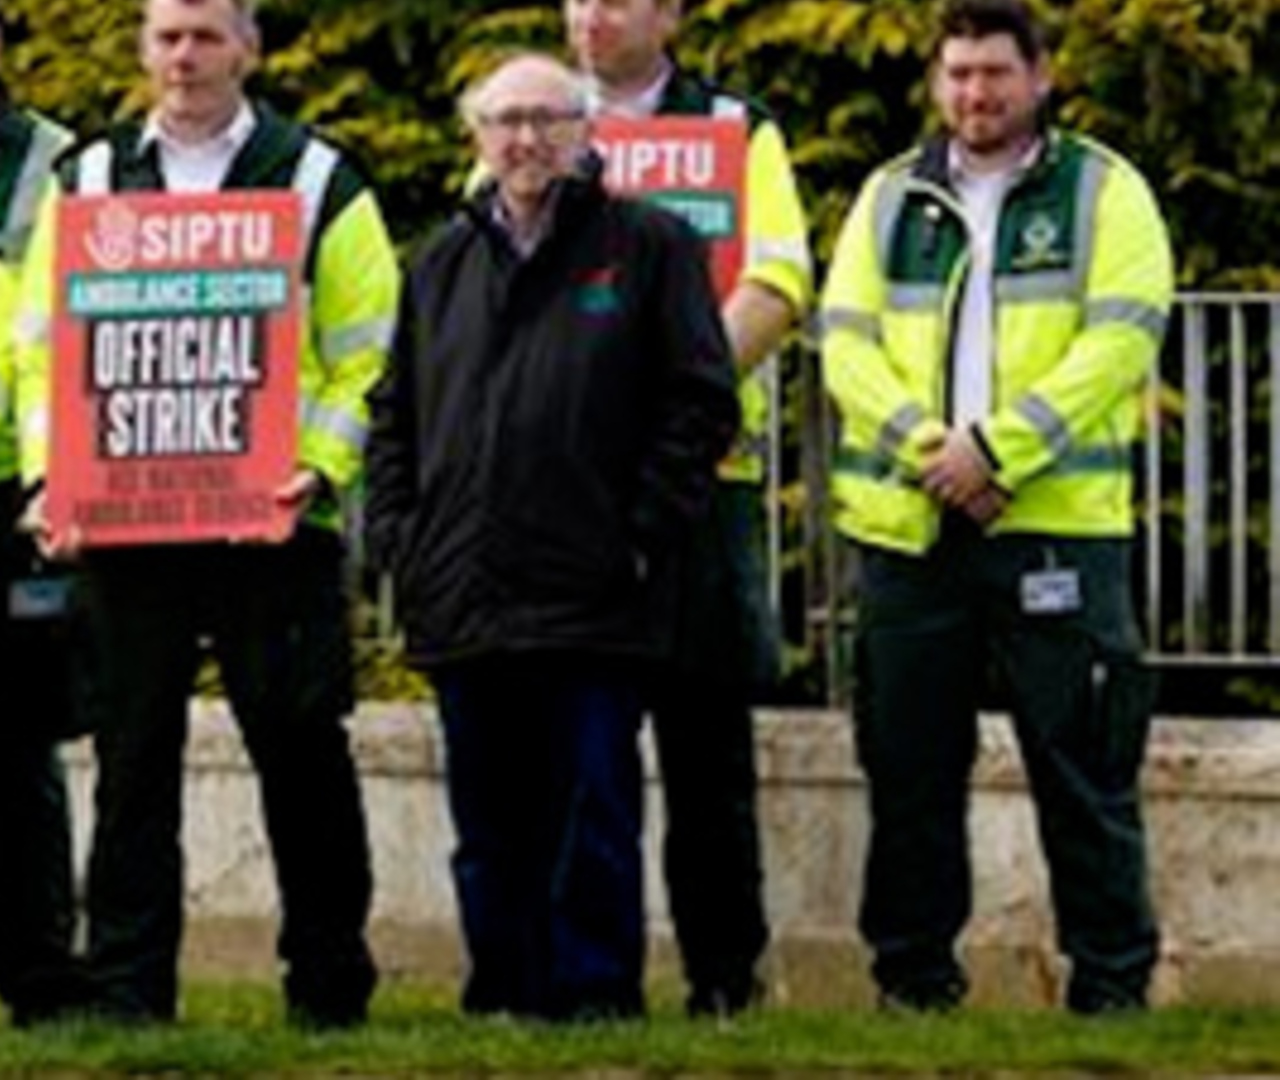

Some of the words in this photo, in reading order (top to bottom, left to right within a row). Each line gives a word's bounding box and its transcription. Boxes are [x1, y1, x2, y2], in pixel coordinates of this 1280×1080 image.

[140, 210, 273, 263] SIPTU
[70, 278, 200, 313] AMBULANCE
[204, 274, 287, 309] SECTOR
[94, 315, 262, 388] OFFICIAL
[107, 387, 243, 458] STRIKE
